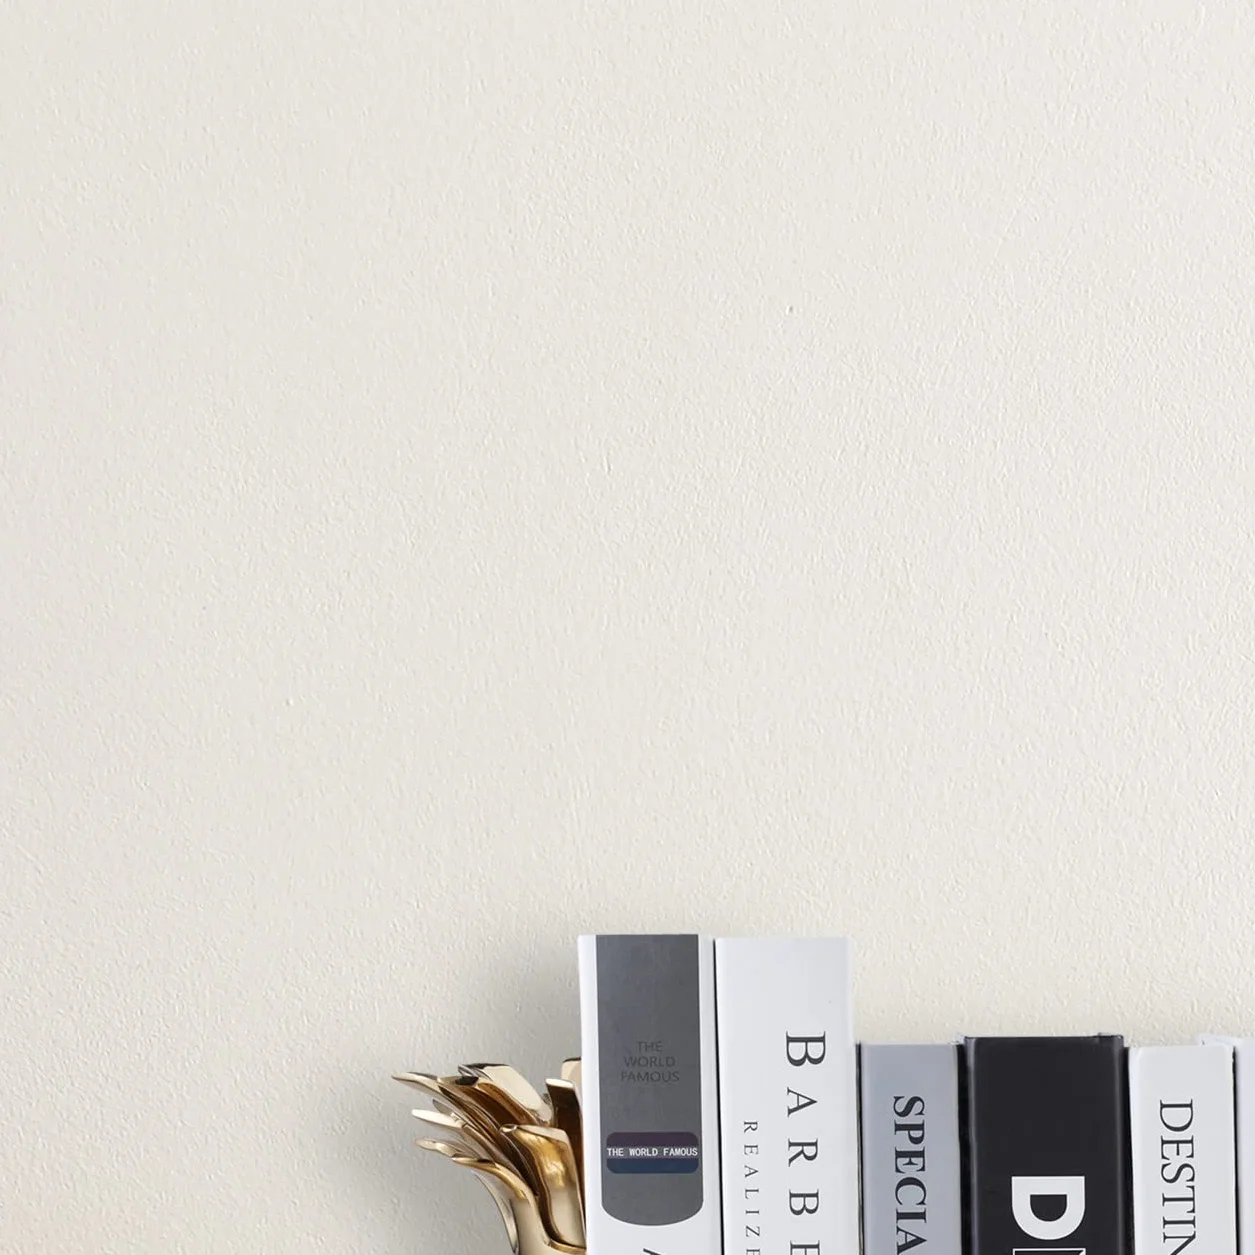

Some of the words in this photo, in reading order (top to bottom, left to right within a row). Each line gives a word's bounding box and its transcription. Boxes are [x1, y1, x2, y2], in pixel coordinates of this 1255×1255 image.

[637, 1041, 663, 1052] THE
[623, 1056, 676, 1068] WORLD
[620, 1071, 680, 1083] FAMOUS
[607, 1147, 624, 1157] THE
[629, 1147, 658, 1157] WORLD
[663, 1147, 698, 1157] FAMOUS
